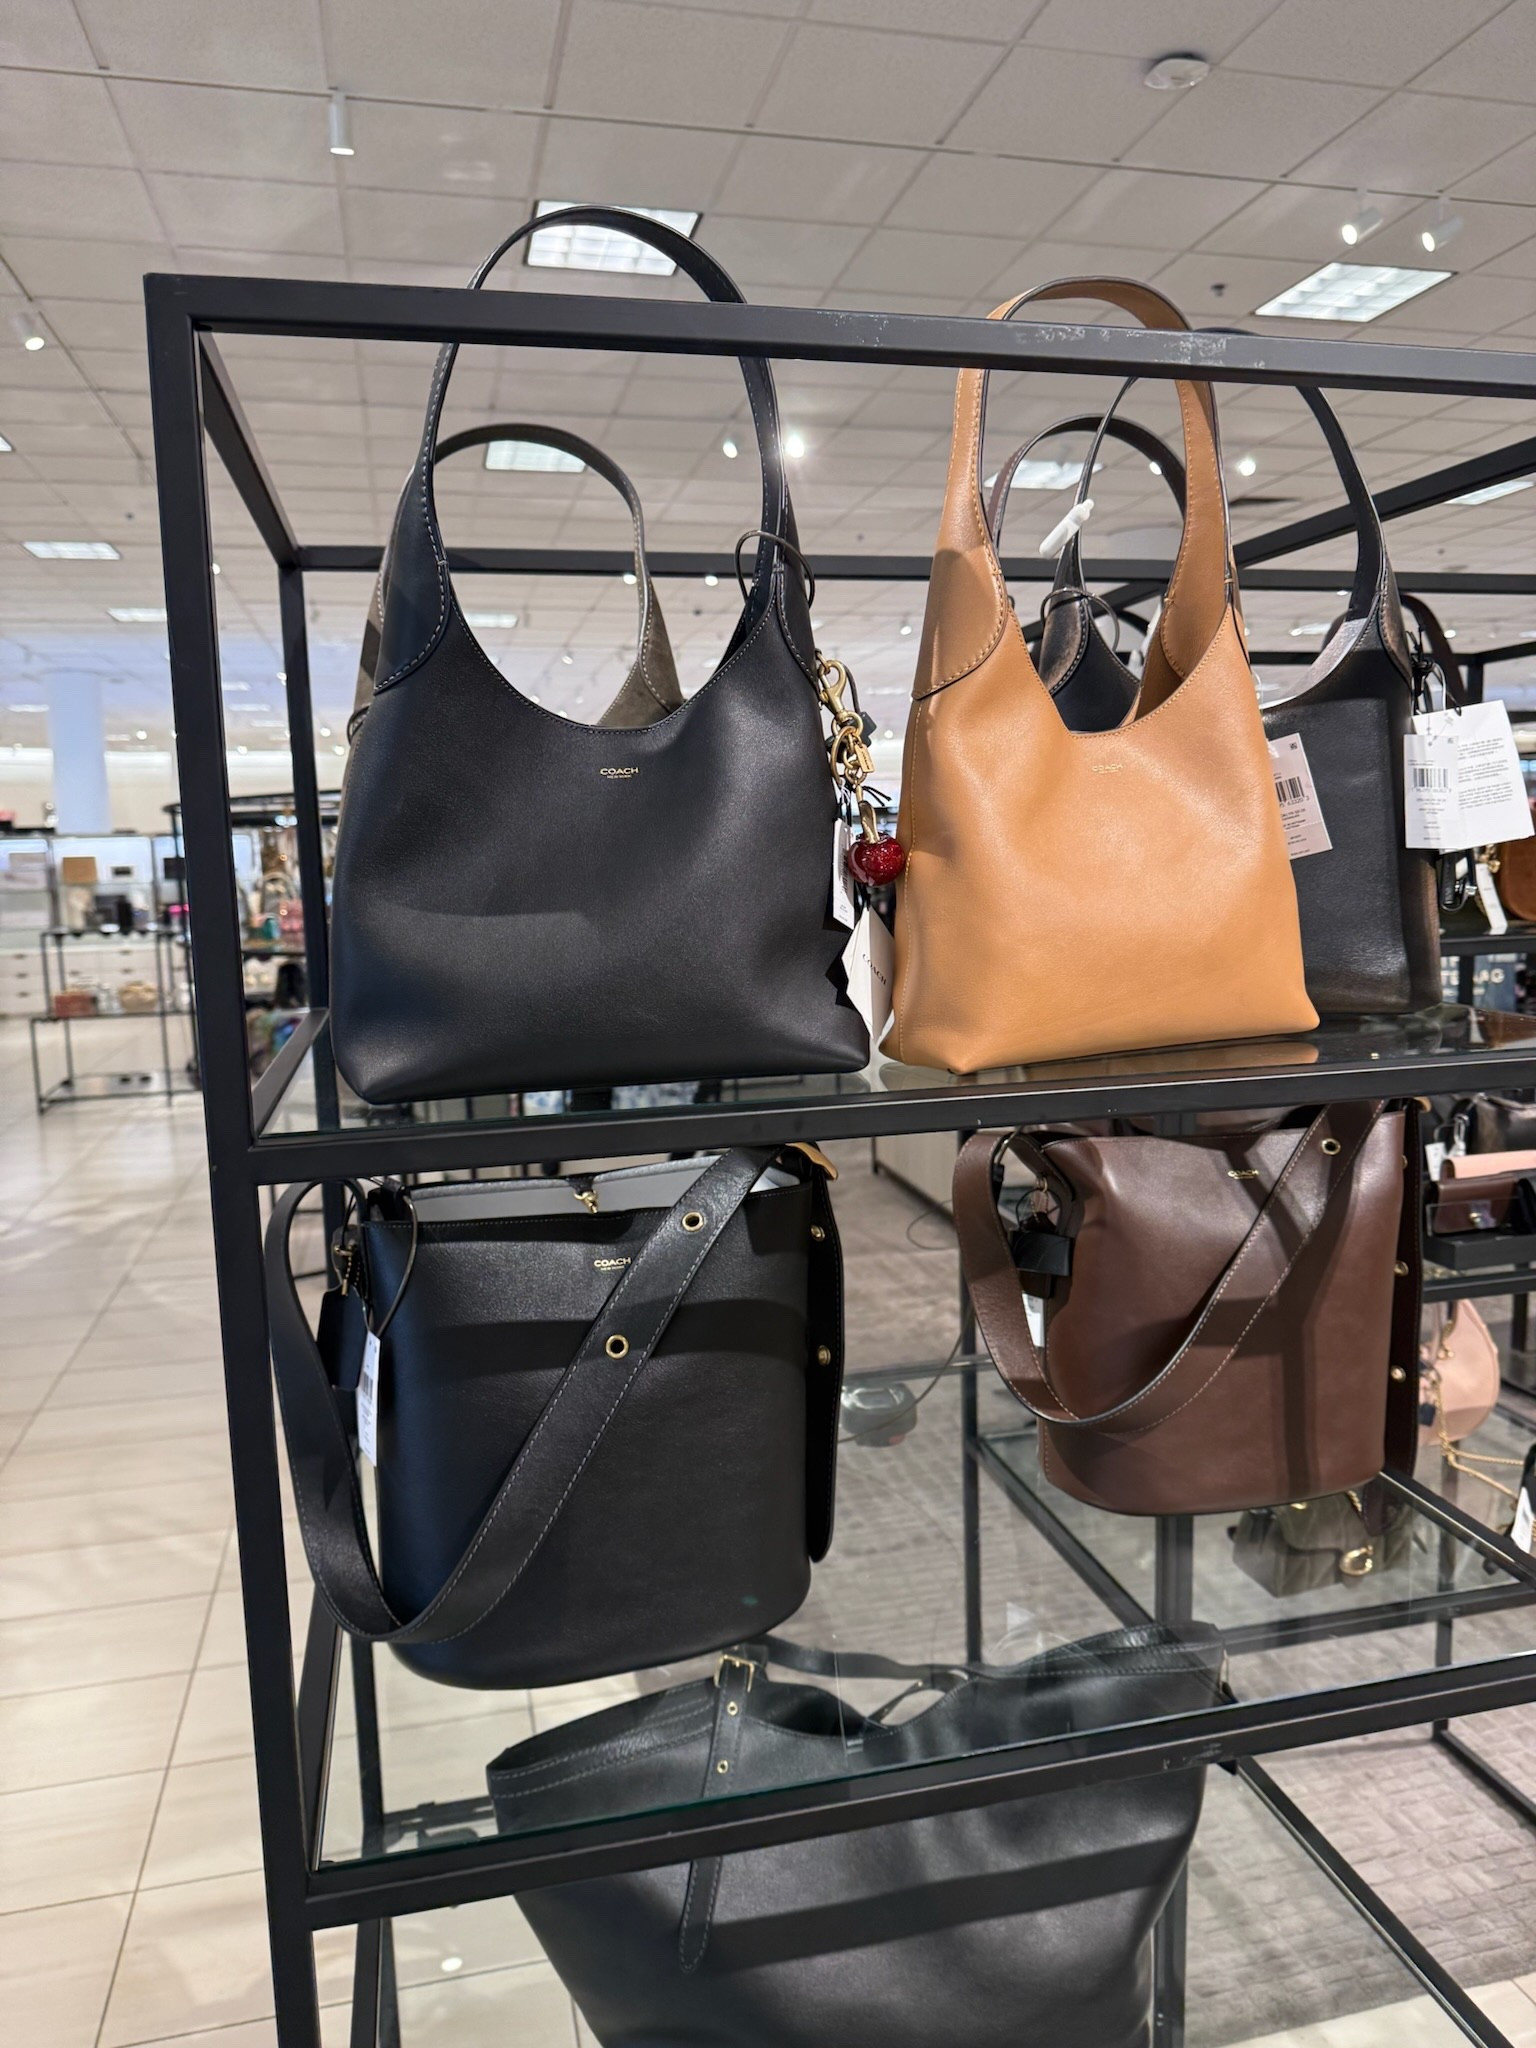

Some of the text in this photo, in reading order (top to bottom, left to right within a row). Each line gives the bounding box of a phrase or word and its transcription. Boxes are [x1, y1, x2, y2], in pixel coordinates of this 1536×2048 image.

[600, 767, 639, 775] COACH
[863, 953, 887, 985] COACH
[594, 1257, 631, 1267] COACH
